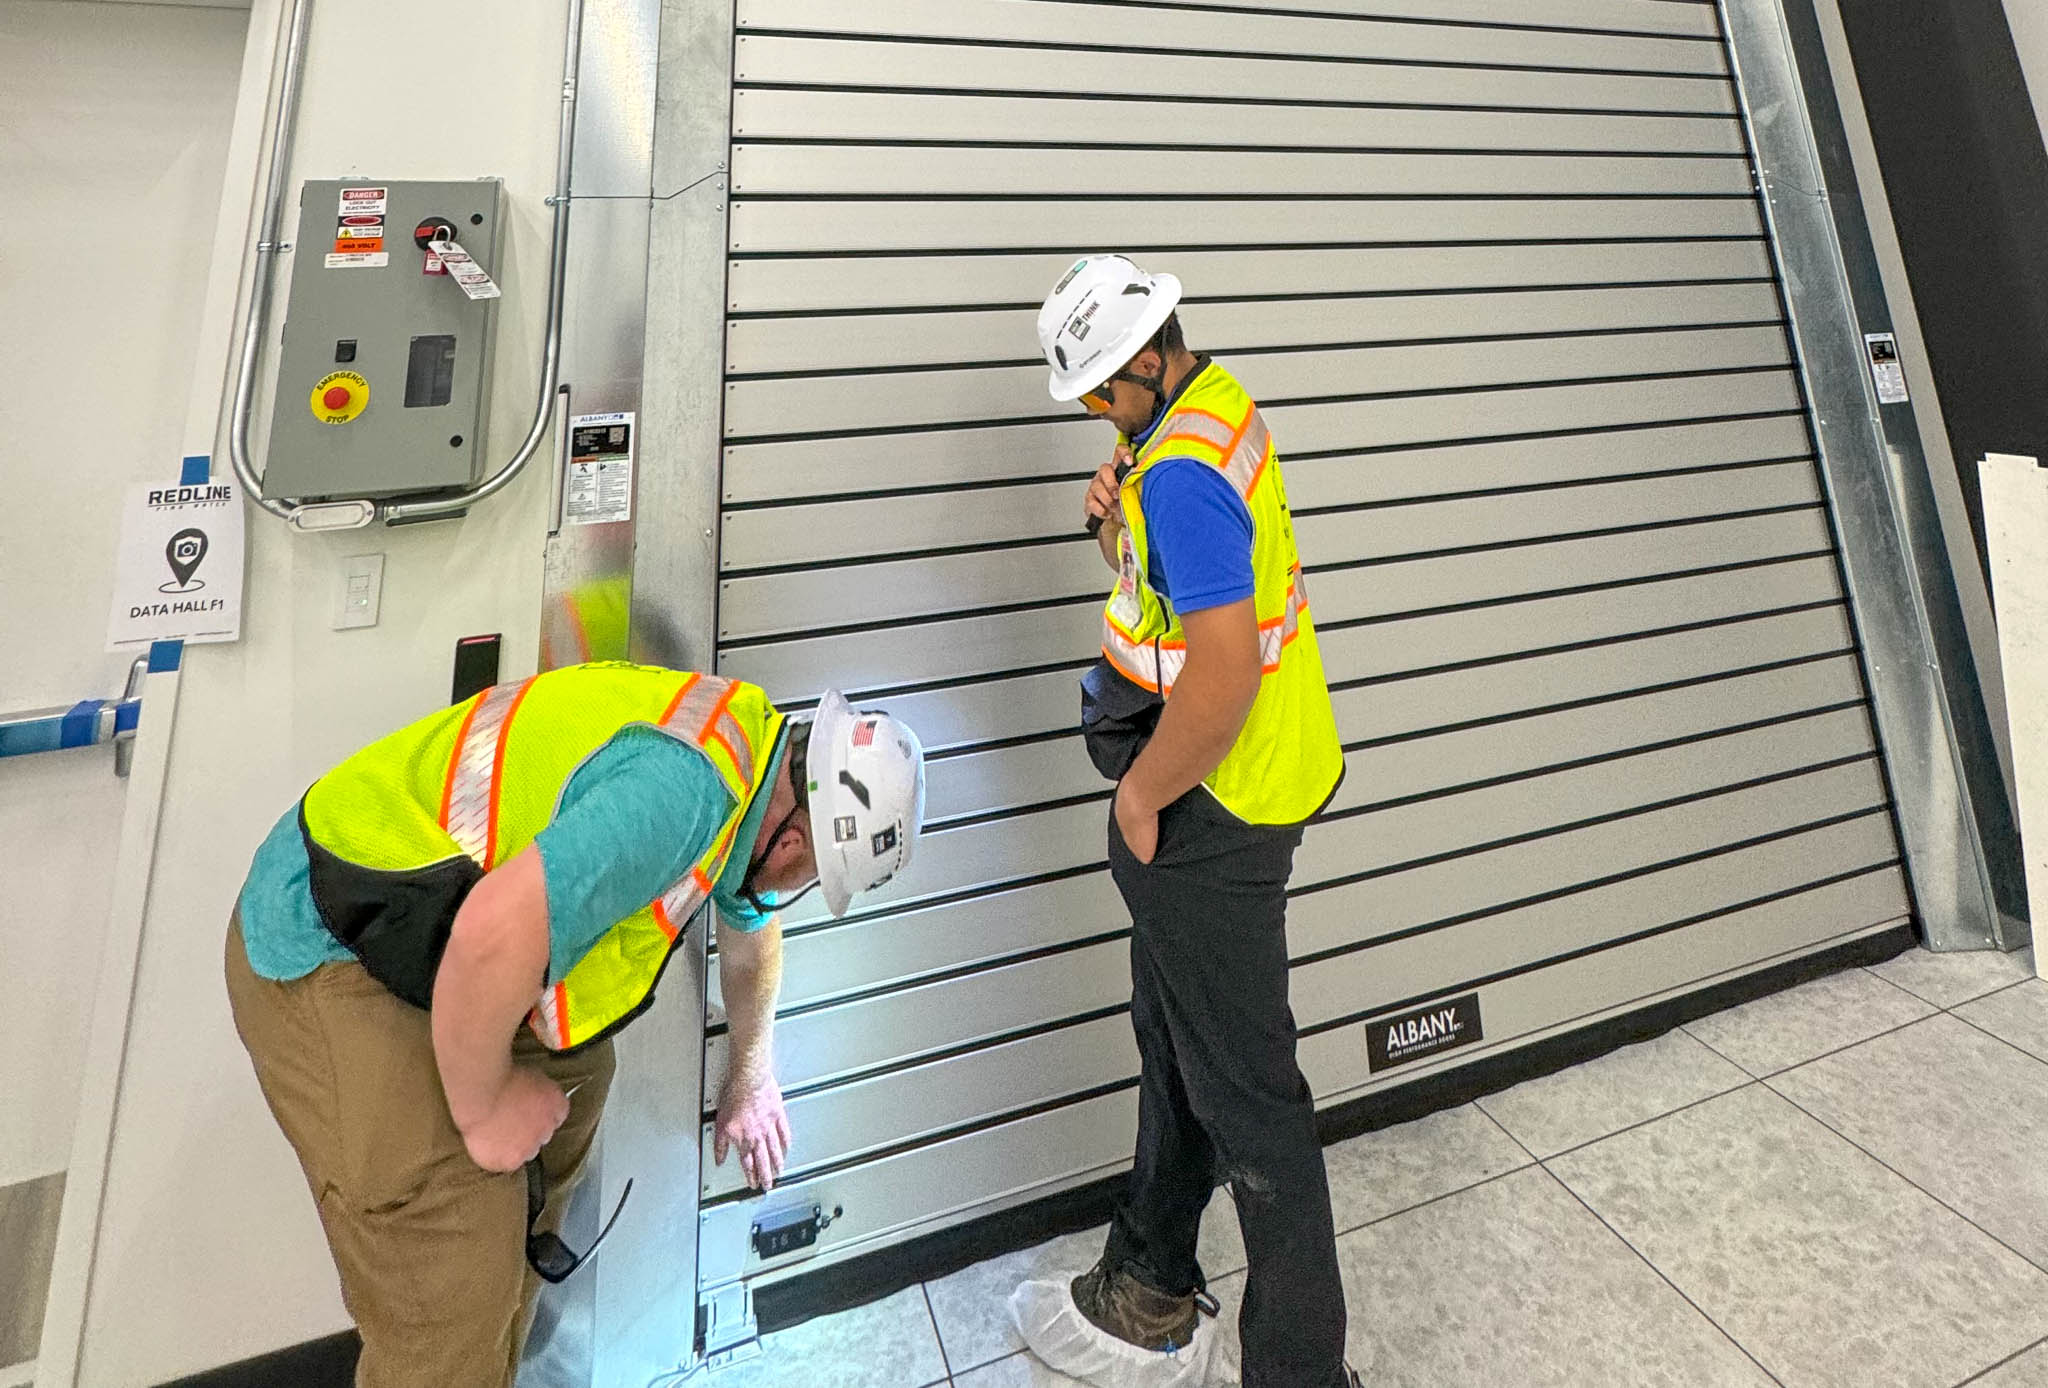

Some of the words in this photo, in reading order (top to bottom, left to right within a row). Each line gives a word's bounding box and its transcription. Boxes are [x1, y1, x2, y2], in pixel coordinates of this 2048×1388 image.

[349, 191, 378, 200] DANGER
[1082, 300, 1101, 321] THINK
[316, 371, 367, 391] EMERGENCY
[325, 414, 350, 424] STOP
[148, 486, 232, 505] REDLINE
[130, 604, 169, 619] DATA
[172, 599, 207, 614] HALL
[210, 599, 225, 611] F1
[1386, 1008, 1456, 1051] ALBANY
